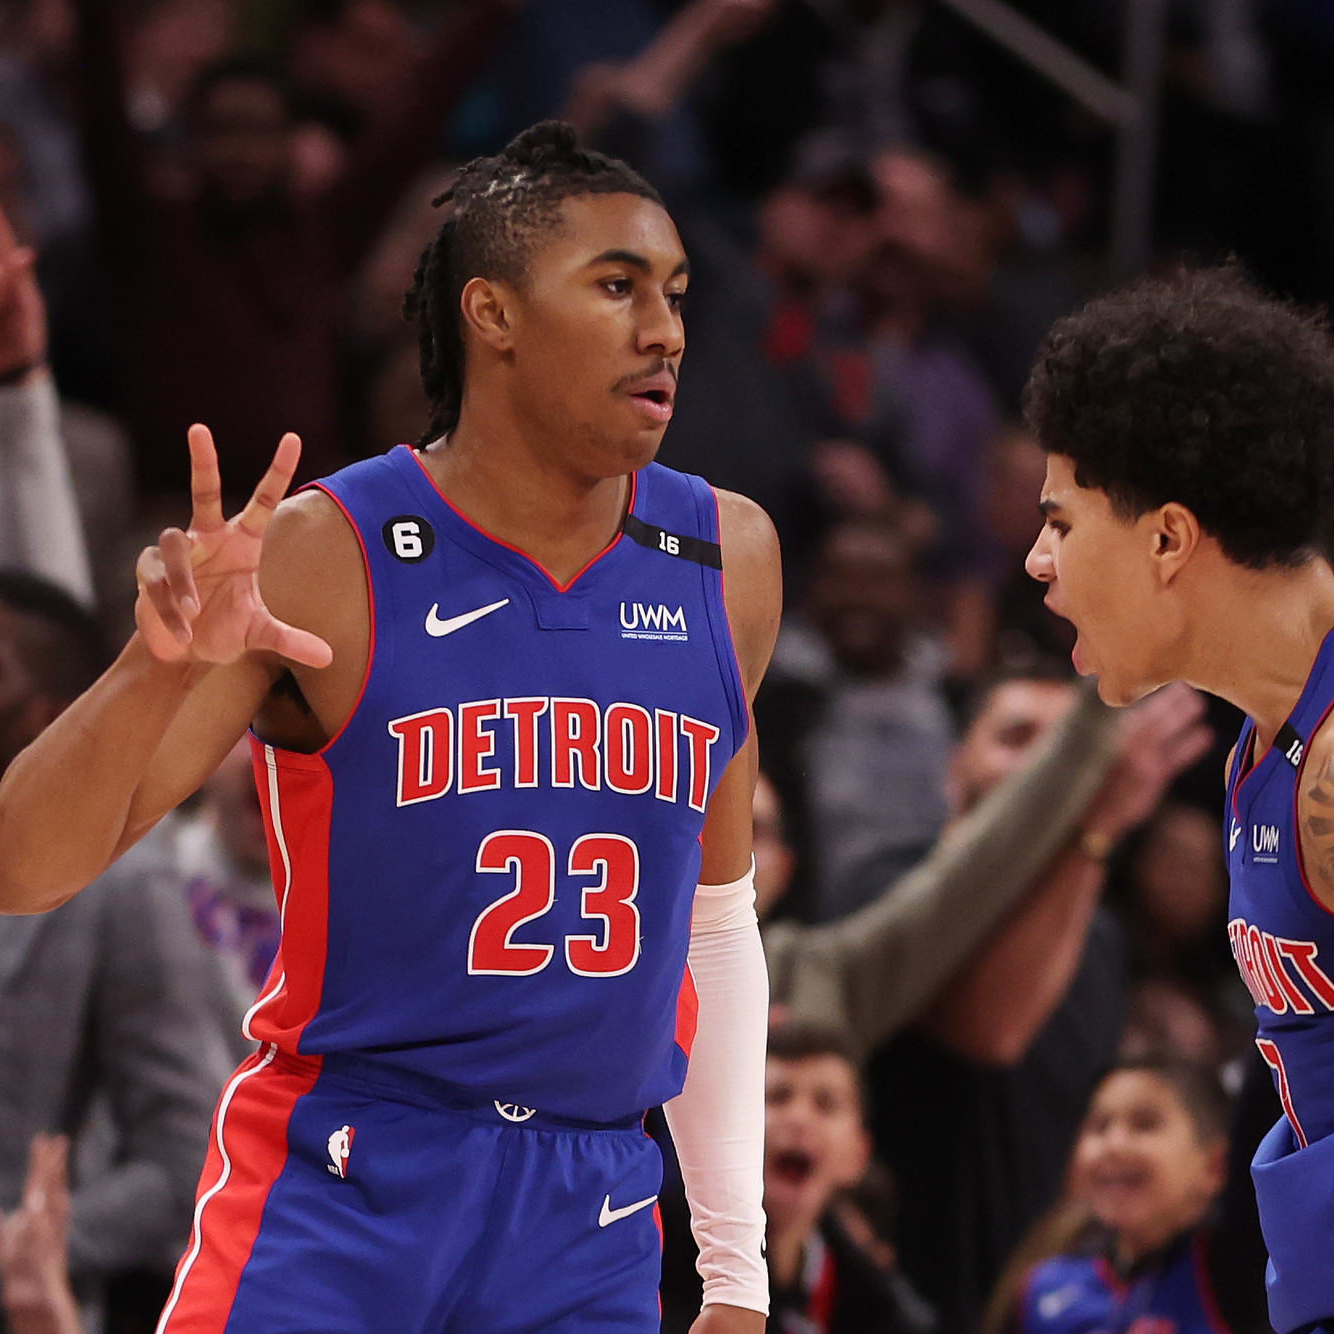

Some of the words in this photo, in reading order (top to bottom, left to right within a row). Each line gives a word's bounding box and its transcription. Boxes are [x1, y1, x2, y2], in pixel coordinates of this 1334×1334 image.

[392, 522, 423, 558] 6
[659, 531, 680, 555] 16
[620, 602, 687, 631] UWM
[388, 696, 720, 813] DETROIT
[1285, 739, 1304, 766] 16
[1253, 824, 1280, 853] UWM
[467, 830, 641, 977] 23
